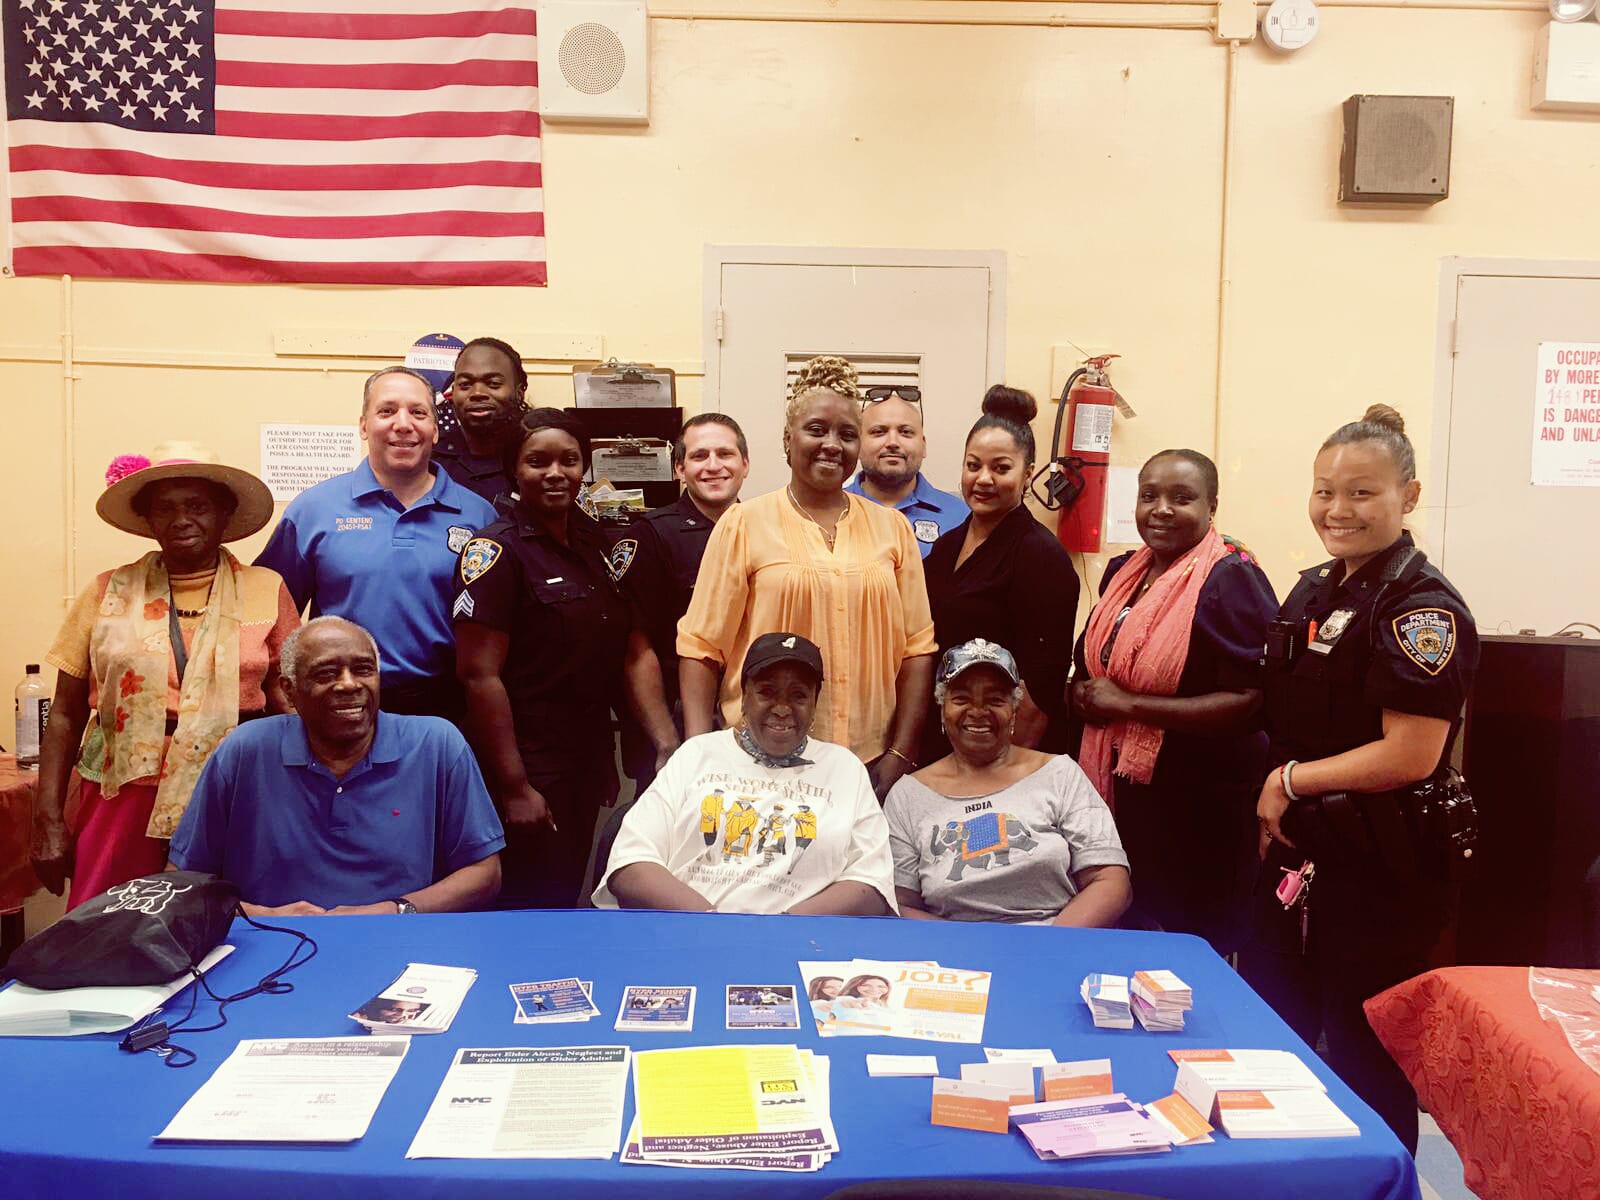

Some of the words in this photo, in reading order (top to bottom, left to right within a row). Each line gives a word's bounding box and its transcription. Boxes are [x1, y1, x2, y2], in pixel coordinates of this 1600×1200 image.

[1545, 369, 1560, 384] BY
[1566, 369, 1600, 385] MORE
[1543, 408, 1555, 422] IS
[1540, 427, 1565, 441] AND
[346, 516, 373, 524] CENTENO
[1409, 613, 1439, 621] POLICE
[1400, 620, 1450, 632] DEPARTMENT
[1403, 640, 1417, 654] CITY
[1415, 654, 1426, 663] OF
[1436, 653, 1448, 666] NEW
[1444, 633, 1453, 652] YORK
[964, 801, 993, 814] INDIA
[895, 970, 990, 991] JOB?
[344, 1041, 392, 1049] relationship
[742, 1132, 806, 1140] Exploitation
[783, 1137, 818, 1145] Report
[735, 1158, 764, 1166] Elder
[767, 1160, 805, 1168] Report
